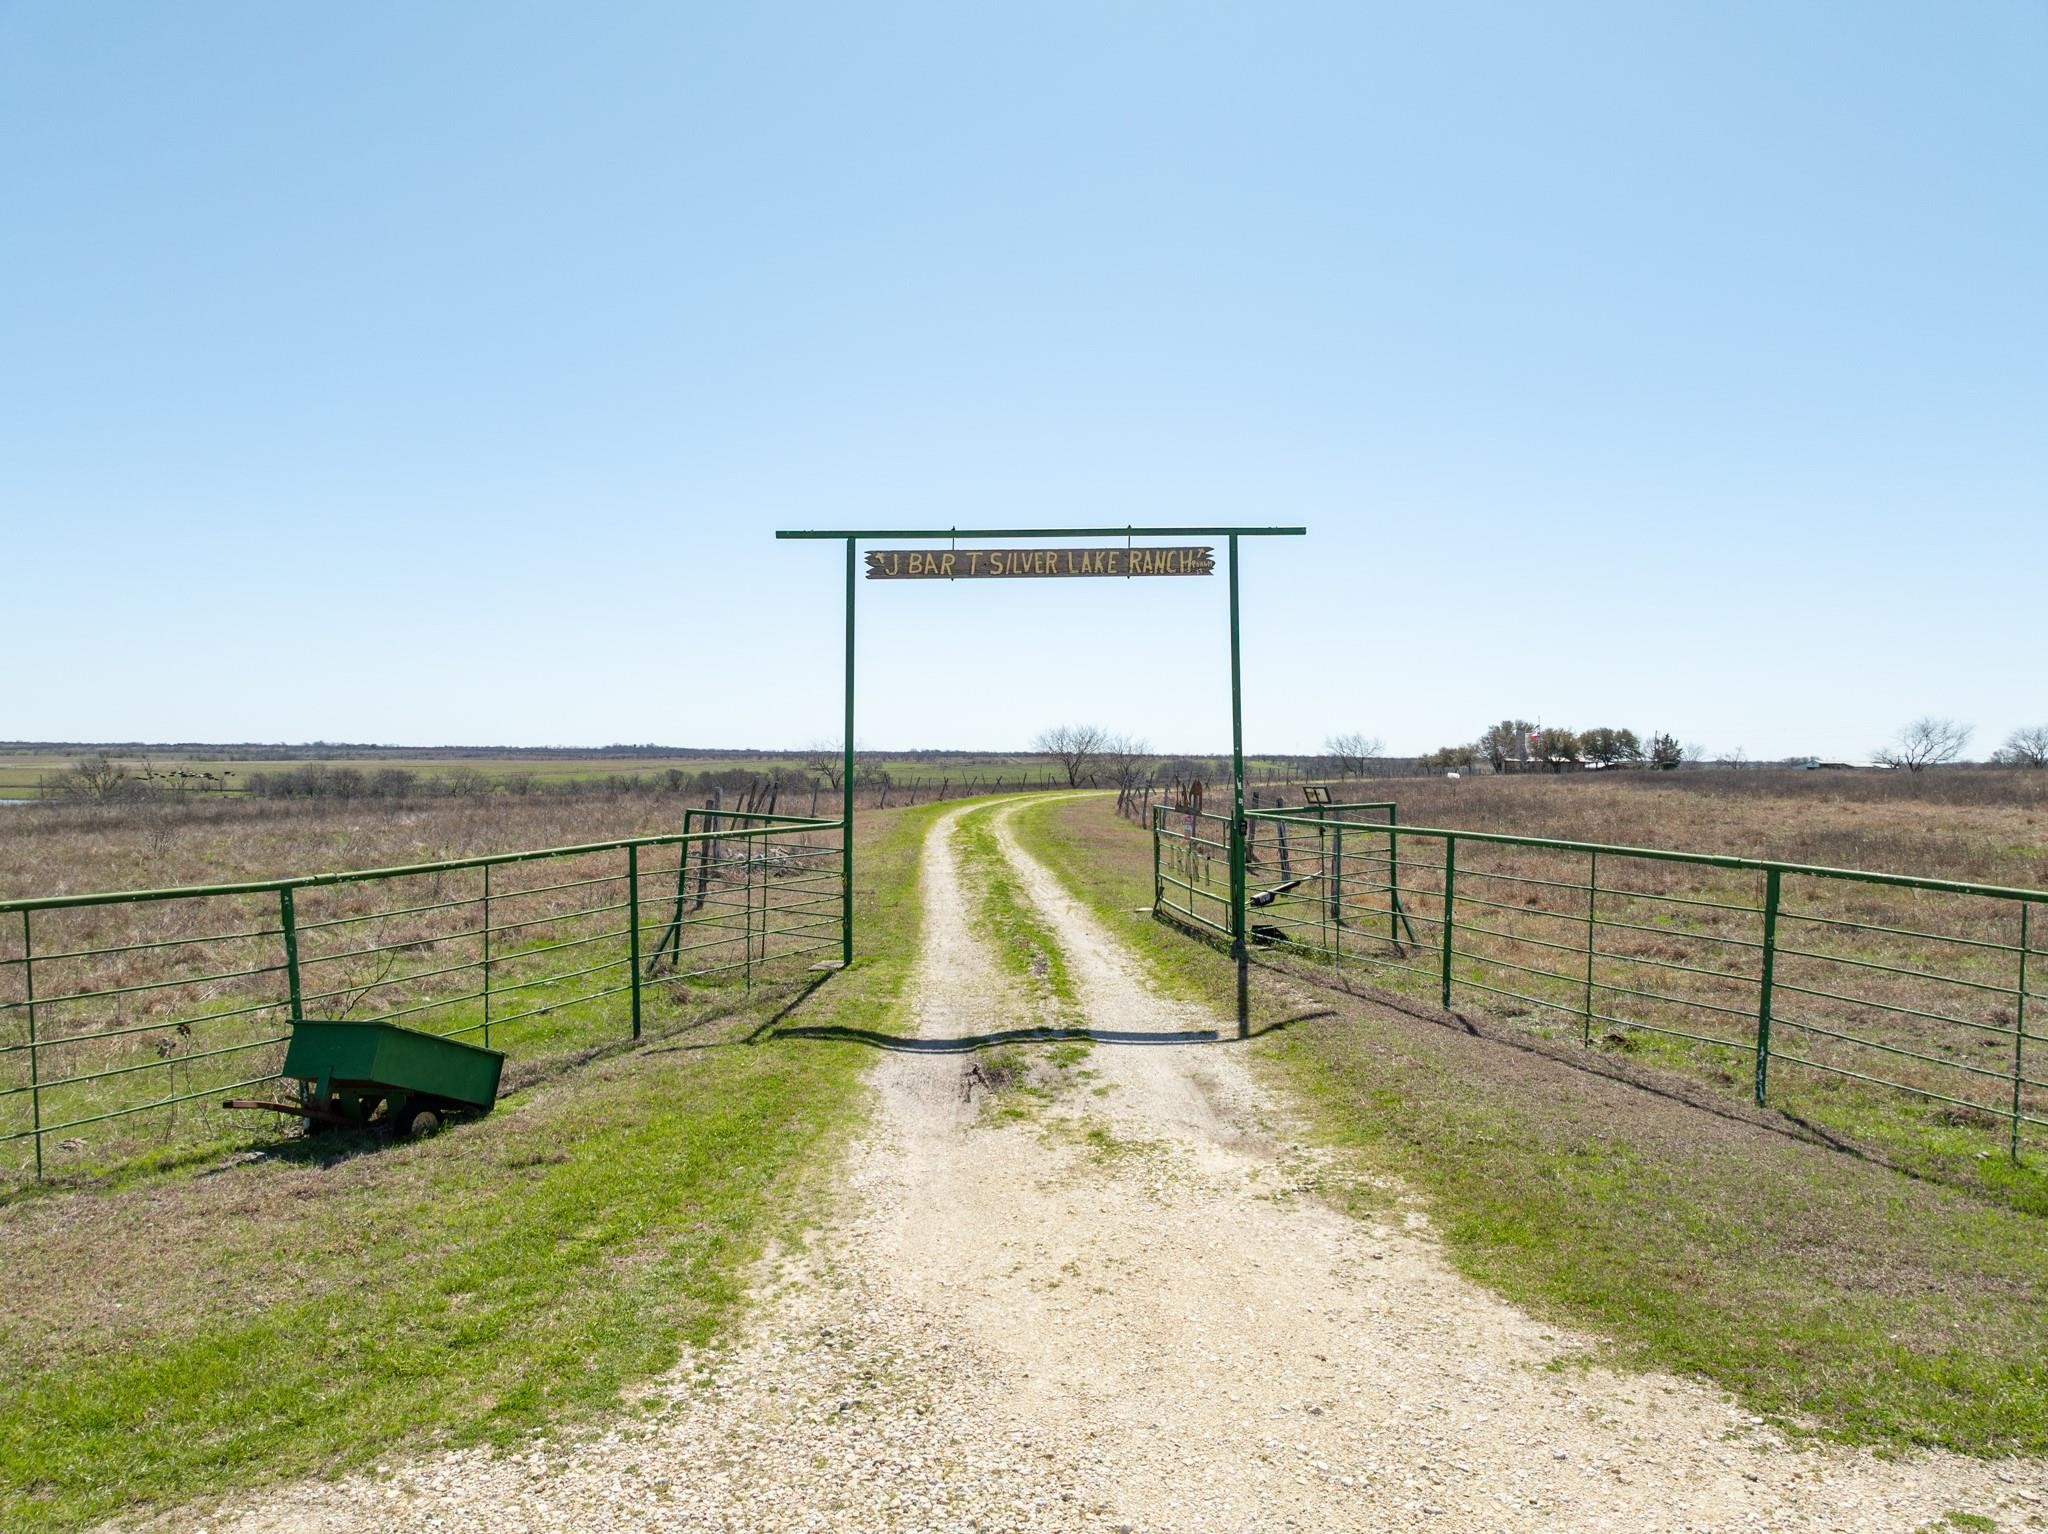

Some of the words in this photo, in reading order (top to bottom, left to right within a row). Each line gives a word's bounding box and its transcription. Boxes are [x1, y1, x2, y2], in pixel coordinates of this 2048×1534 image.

[885, 553, 898, 576] J
[908, 552, 955, 576] BAR
[966, 552, 983, 575] T
[990, 551, 1058, 575] SILVER
[1068, 551, 1120, 574] LAKE
[1129, 549, 1193, 574] RANCH
